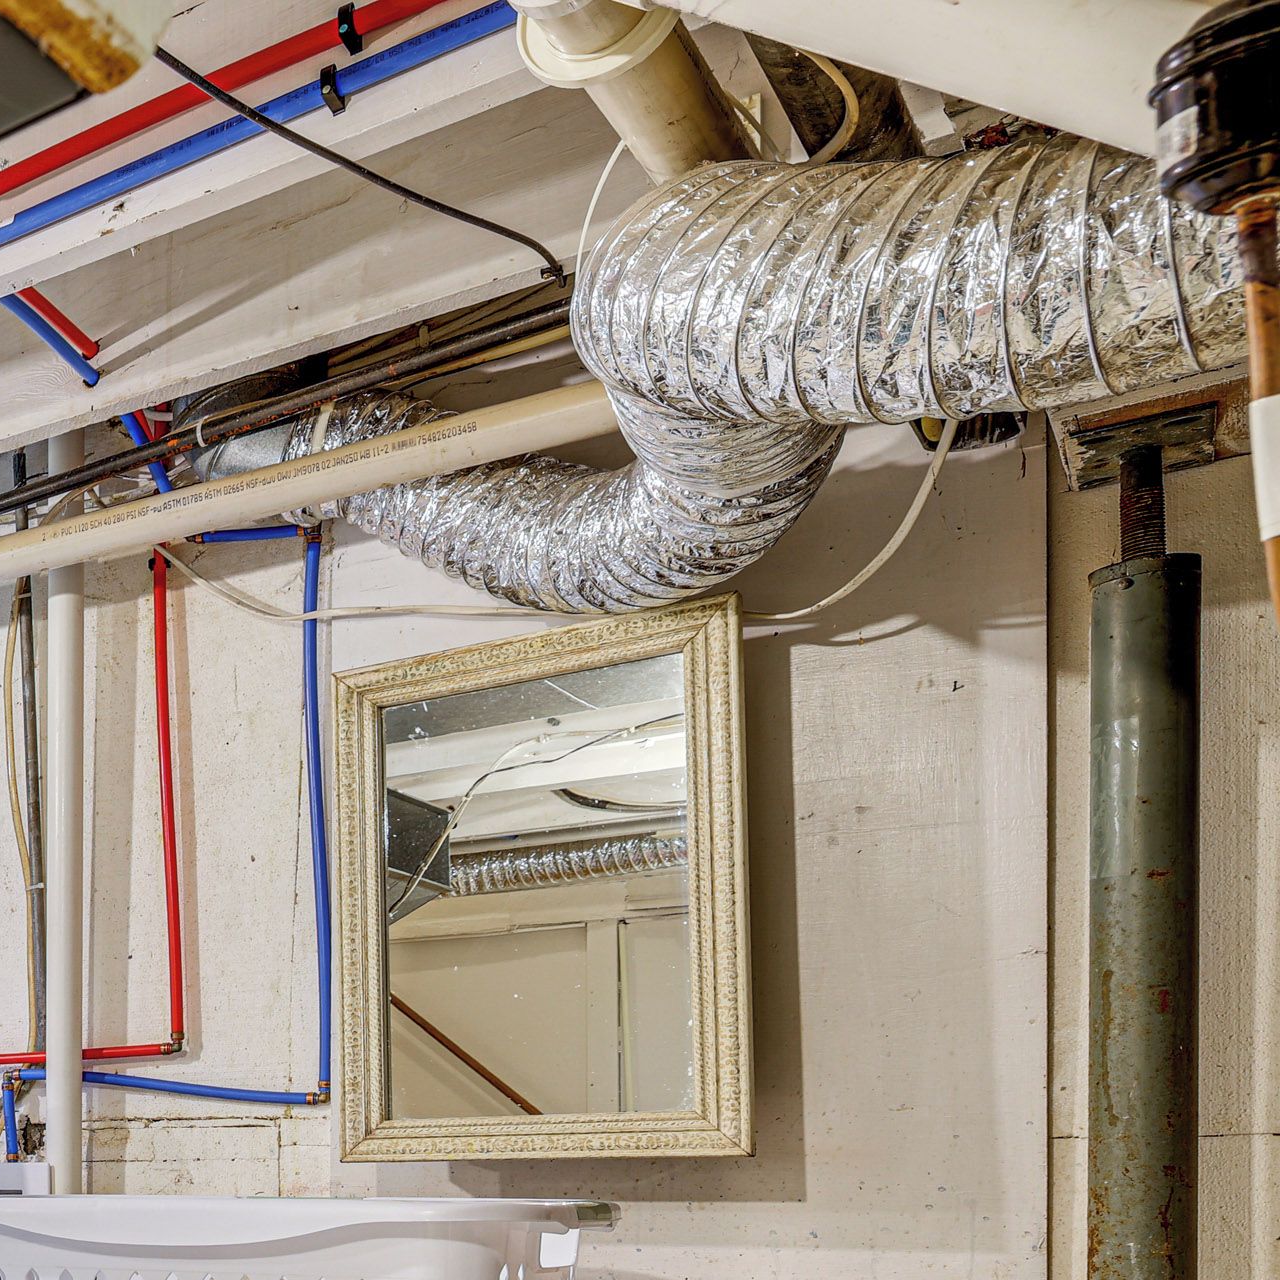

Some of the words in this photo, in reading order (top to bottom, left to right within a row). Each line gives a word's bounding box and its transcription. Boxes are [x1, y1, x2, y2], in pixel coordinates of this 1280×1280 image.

[60, 527, 72, 537] PVC
[74, 523, 89, 533] 1120
[89, 519, 103, 529] SCH
[103, 517, 112, 526] 40
[112, 514, 125, 524] 280
[125, 511, 137, 520] PSI
[162, 499, 181, 511] ASTM
[203, 488, 222, 500] ASTM
